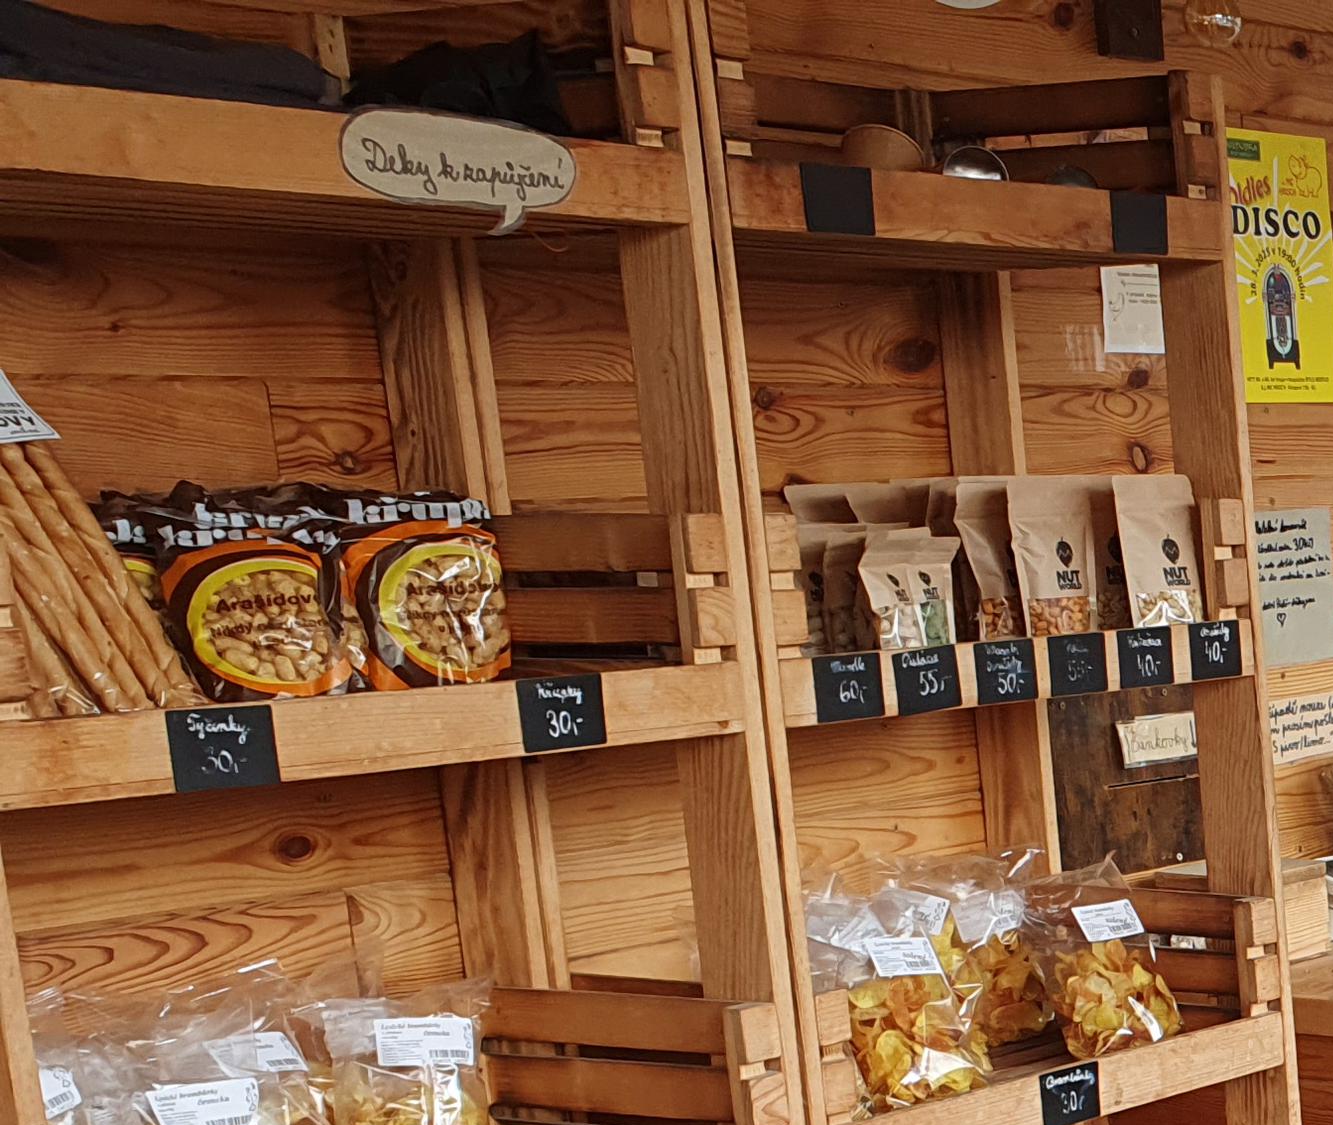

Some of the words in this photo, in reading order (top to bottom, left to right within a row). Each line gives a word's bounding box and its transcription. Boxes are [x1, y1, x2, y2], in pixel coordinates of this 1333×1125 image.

[437, 151, 460, 182] k
[1231, 204, 1321, 240] DISCO
[1056, 569, 1080, 584] NUT
[1163, 566, 1188, 580] NUT
[1204, 640, 1227, 664] 40,-
[839, 680, 868, 704] 60,-
[919, 668, 952, 696] 55,-
[997, 672, 1024, 694] 50,-
[546, 709, 584, 738] 30,-
